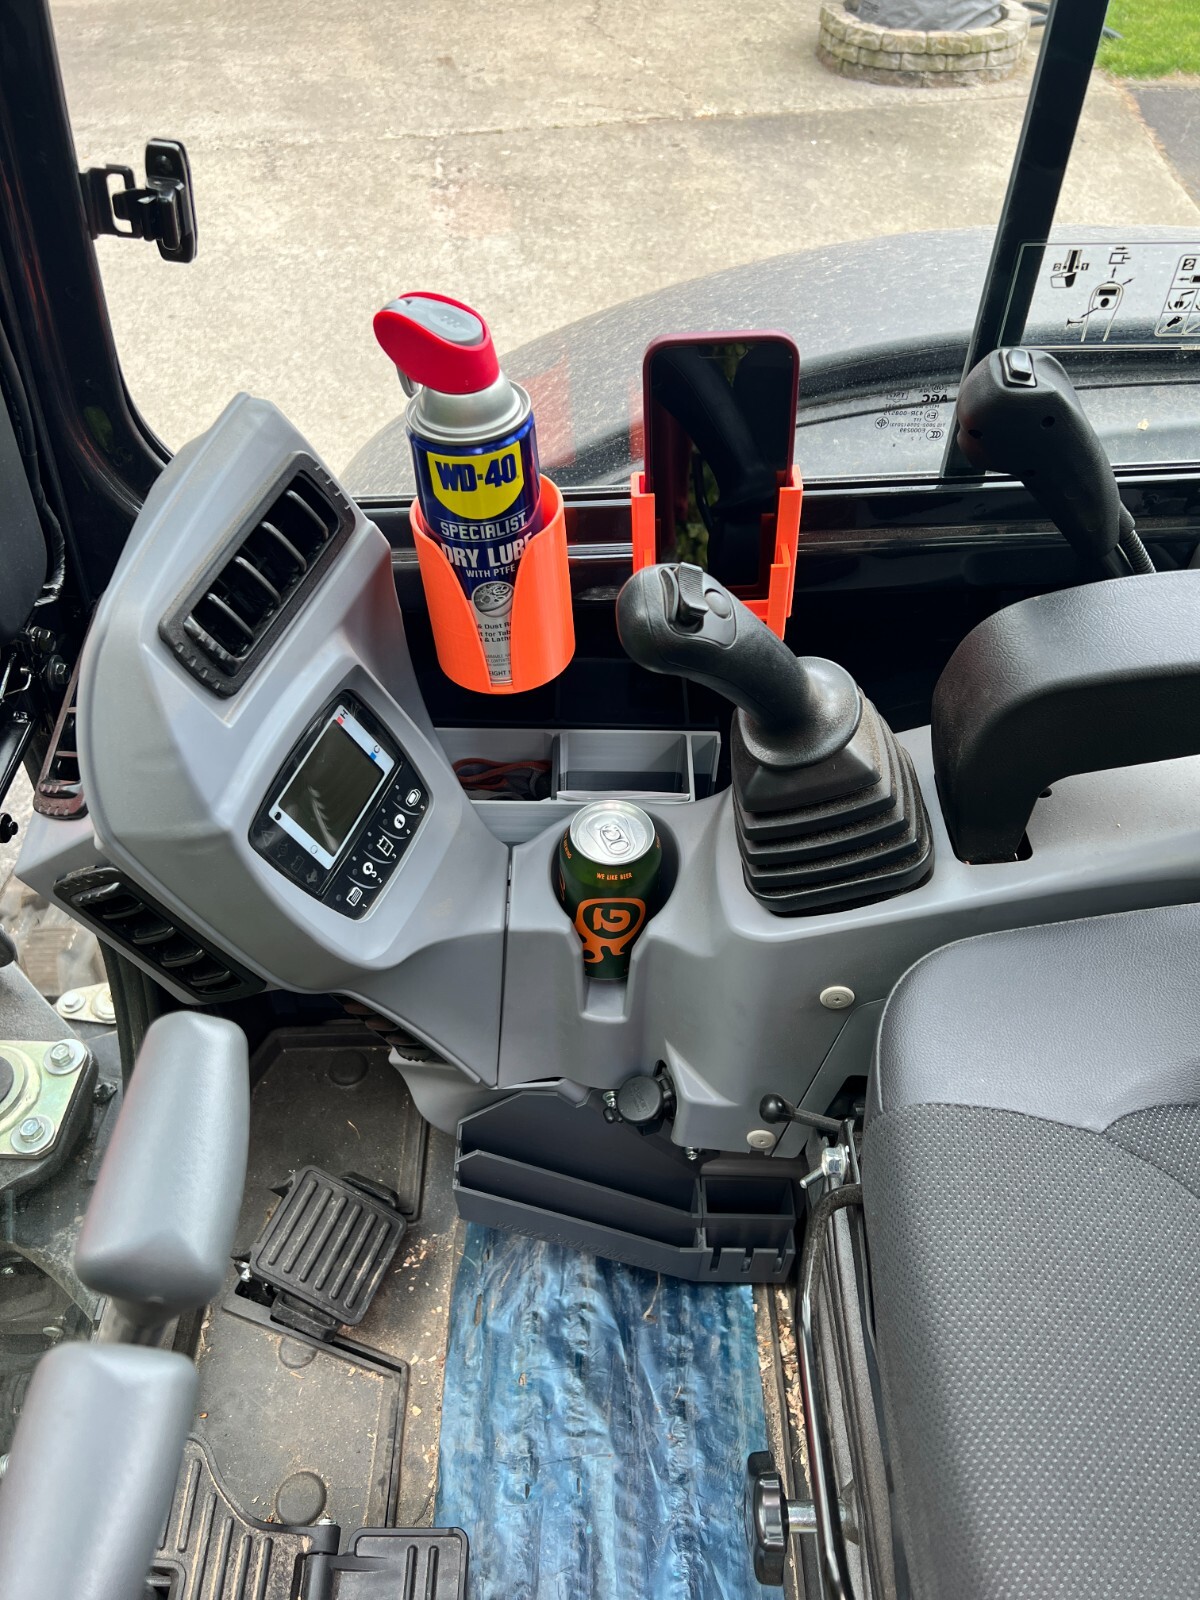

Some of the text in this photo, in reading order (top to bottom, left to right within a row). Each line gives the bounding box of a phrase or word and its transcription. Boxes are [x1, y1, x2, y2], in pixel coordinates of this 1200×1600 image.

[435, 454, 516, 492] WD-40
[440, 512, 526, 539] SPECIALIST
[441, 542, 479, 568] DRY
[466, 564, 515, 577] WITH PTFE
[340, 709, 348, 719] H
[374, 745, 380, 753] C
